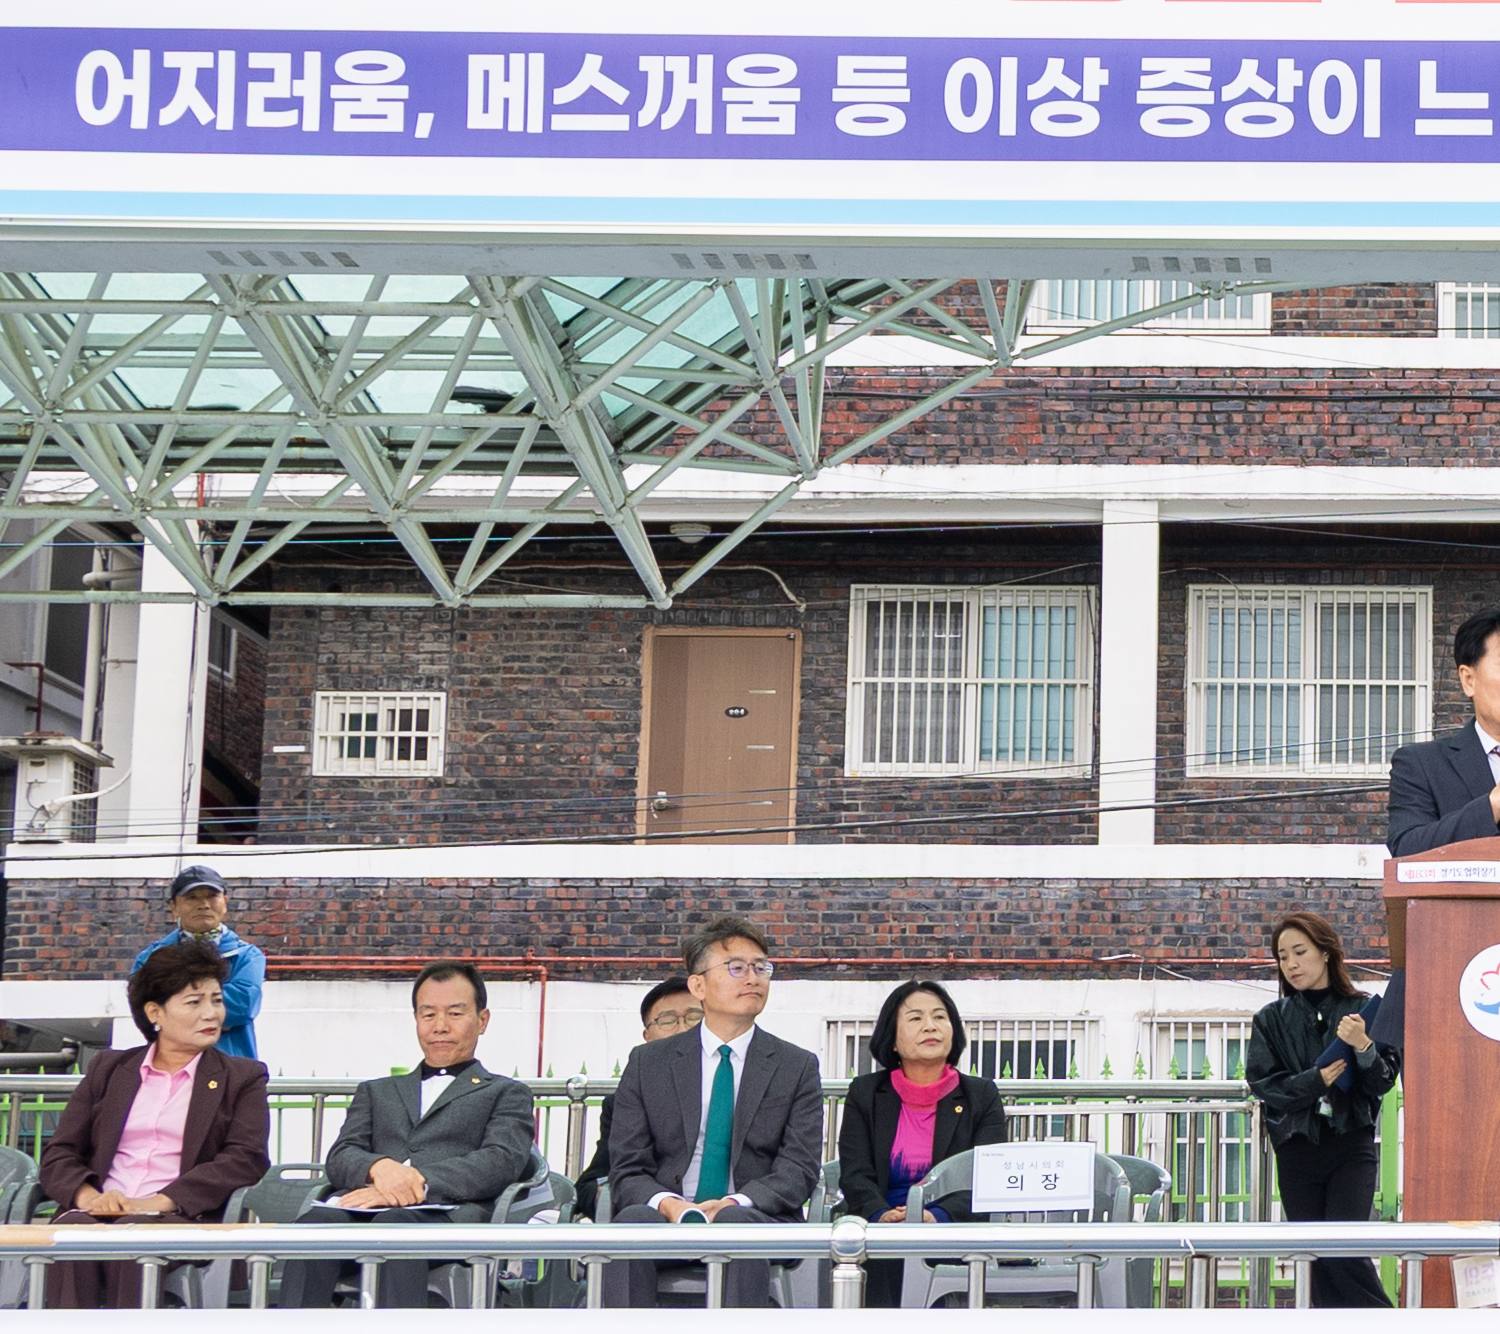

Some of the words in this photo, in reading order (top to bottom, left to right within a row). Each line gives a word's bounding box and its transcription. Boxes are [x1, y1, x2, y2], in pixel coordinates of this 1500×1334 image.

[75, 49, 436, 138] 어지러움,
[467, 52, 801, 136] 메스꺼움
[831, 56, 911, 135] 등
[943, 58, 1109, 137] 이상
[1136, 59, 1381, 139] 증상이
